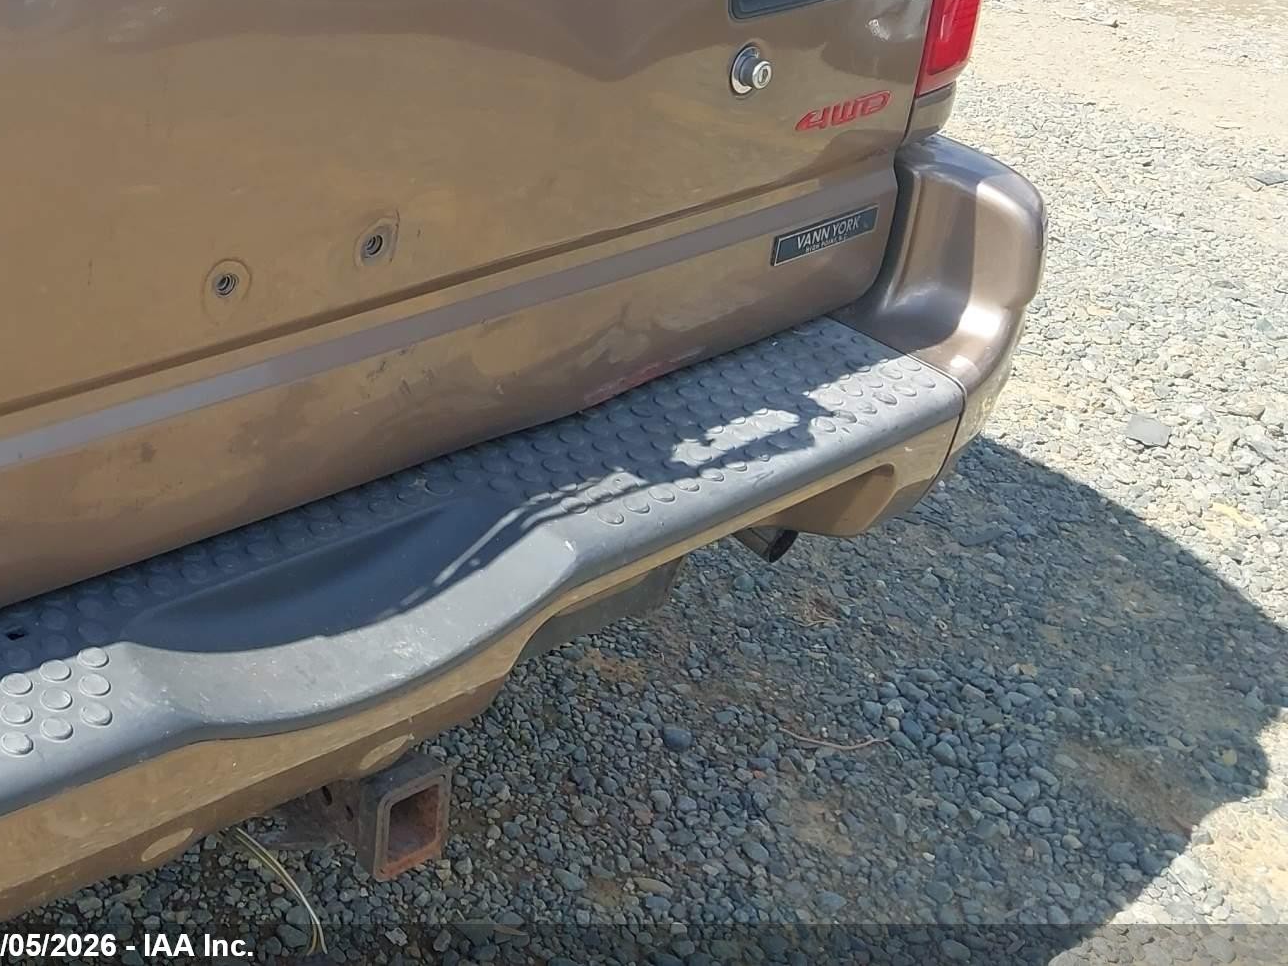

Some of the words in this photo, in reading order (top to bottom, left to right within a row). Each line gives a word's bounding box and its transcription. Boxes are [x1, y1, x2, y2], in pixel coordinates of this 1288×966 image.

[794, 89, 894, 131] 4WD
[797, 226, 831, 249] VANN
[832, 215, 862, 236] YORK
